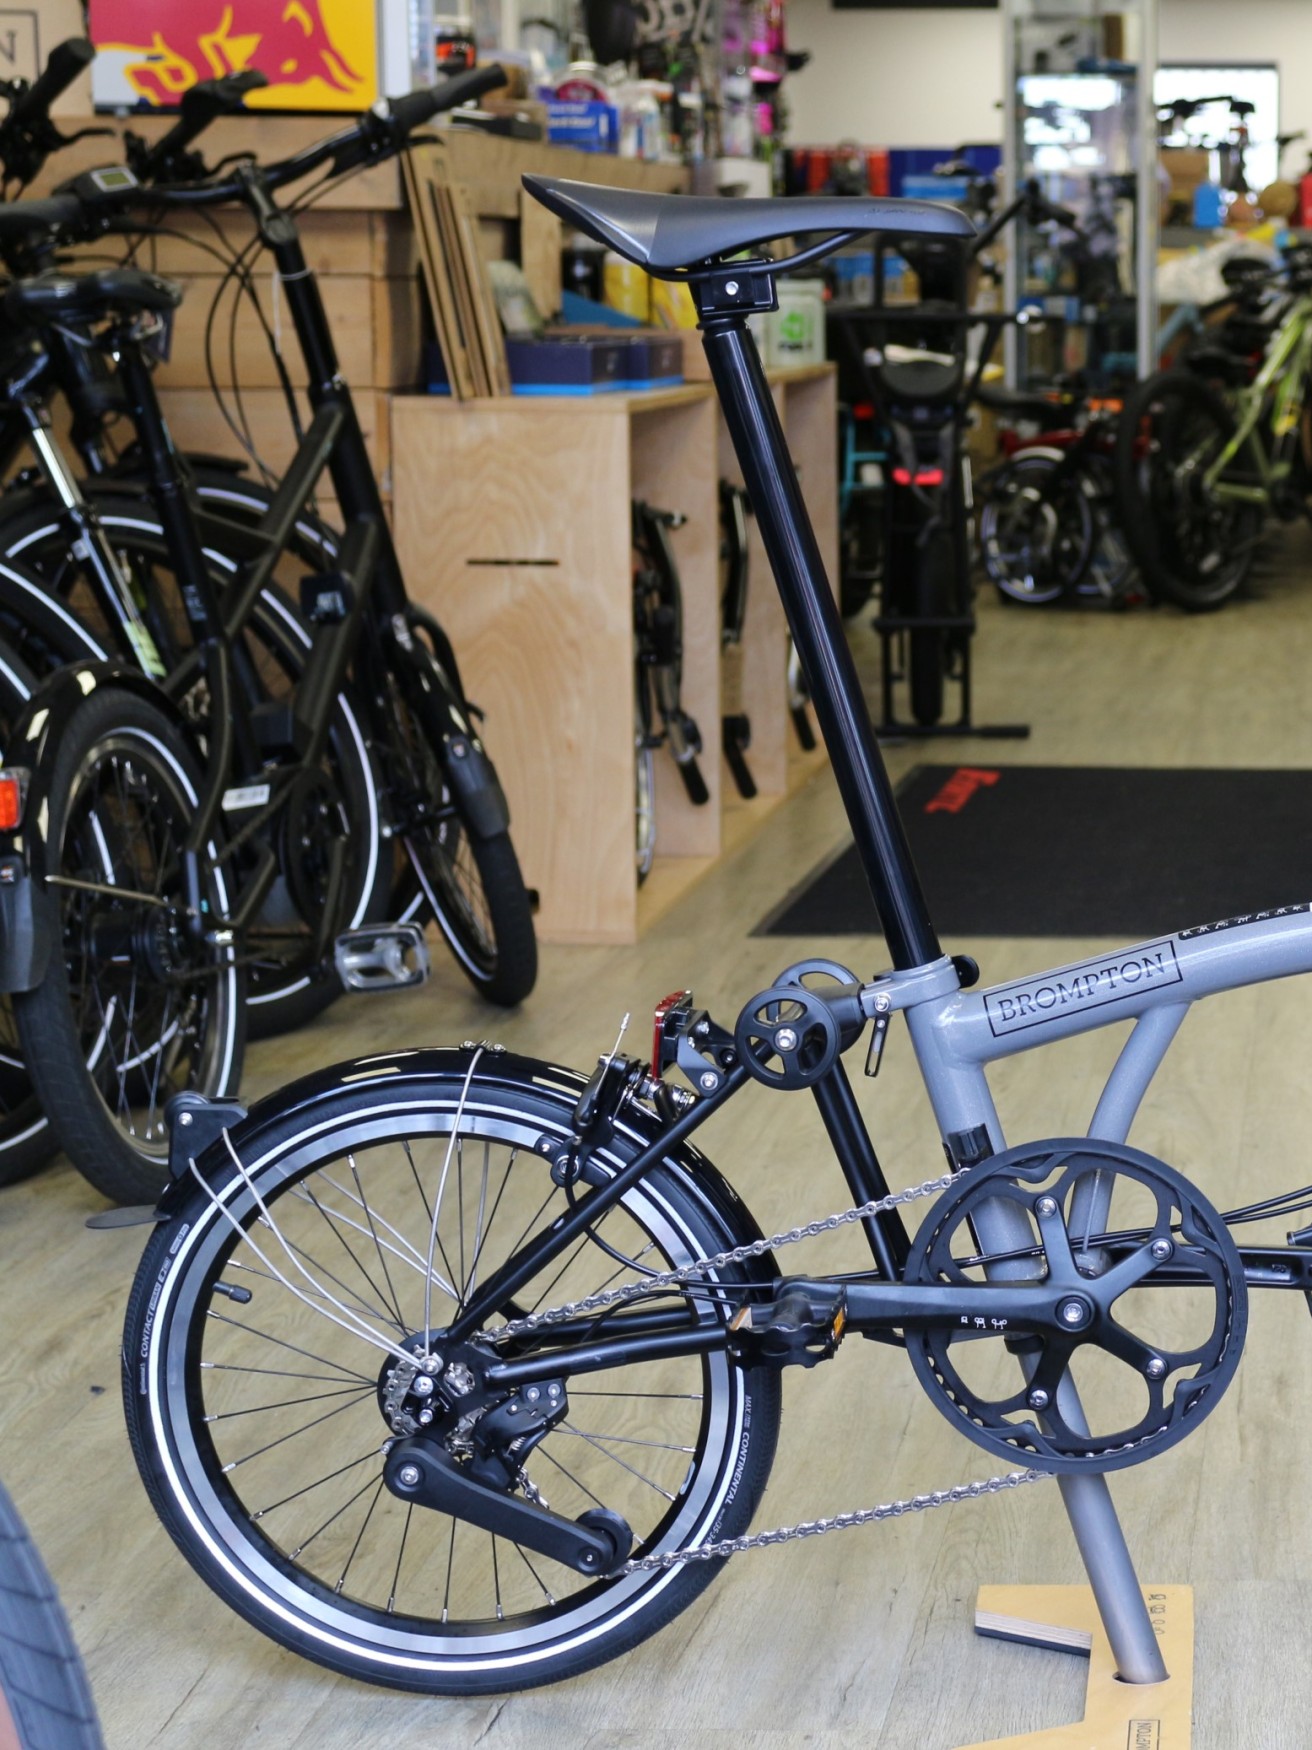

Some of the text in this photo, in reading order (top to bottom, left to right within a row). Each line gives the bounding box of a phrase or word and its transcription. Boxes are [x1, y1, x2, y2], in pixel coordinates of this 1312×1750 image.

[998, 953, 1165, 1021] BROMPTON
[141, 1309, 154, 1358] CONTACT
[725, 1431, 750, 1505] CONTINENTAL
